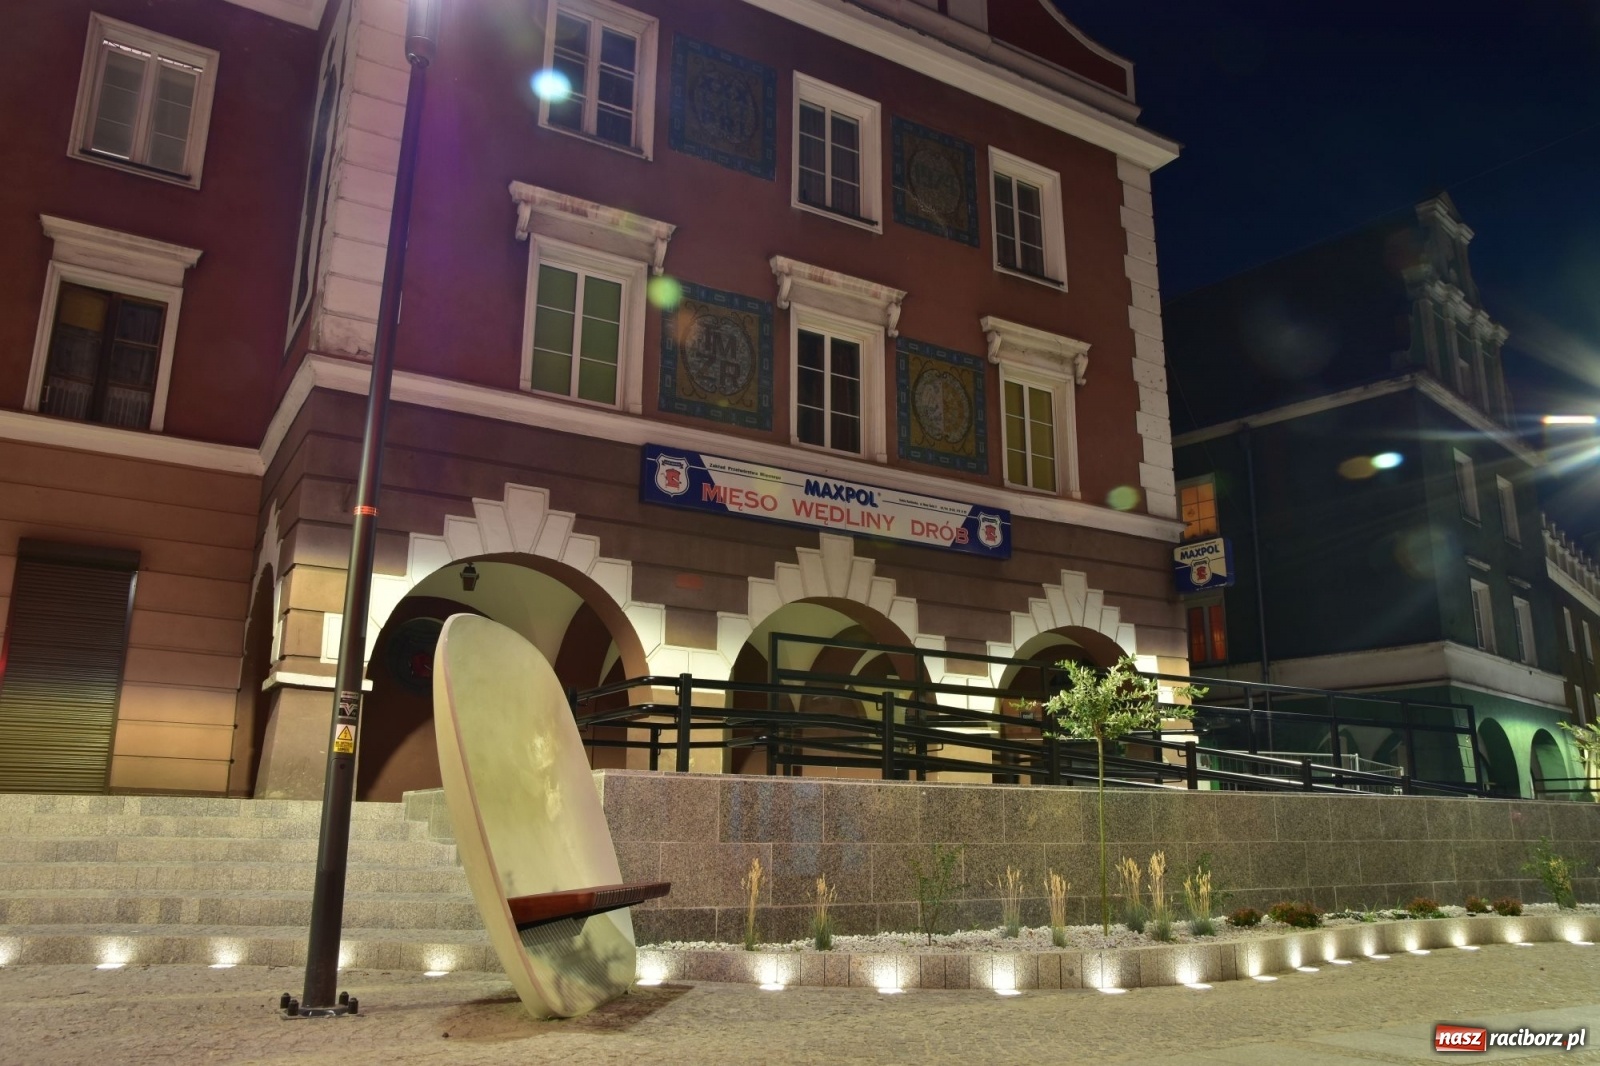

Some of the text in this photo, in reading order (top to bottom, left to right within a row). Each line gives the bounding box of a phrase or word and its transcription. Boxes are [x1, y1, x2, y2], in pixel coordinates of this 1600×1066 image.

[804, 478, 879, 508] MAXPOL
[701, 482, 778, 512] MIĘSO
[792, 498, 895, 531] WĘDLINY
[911, 520, 970, 545] DRÓB
[1180, 544, 1220, 560] MAXPOL
